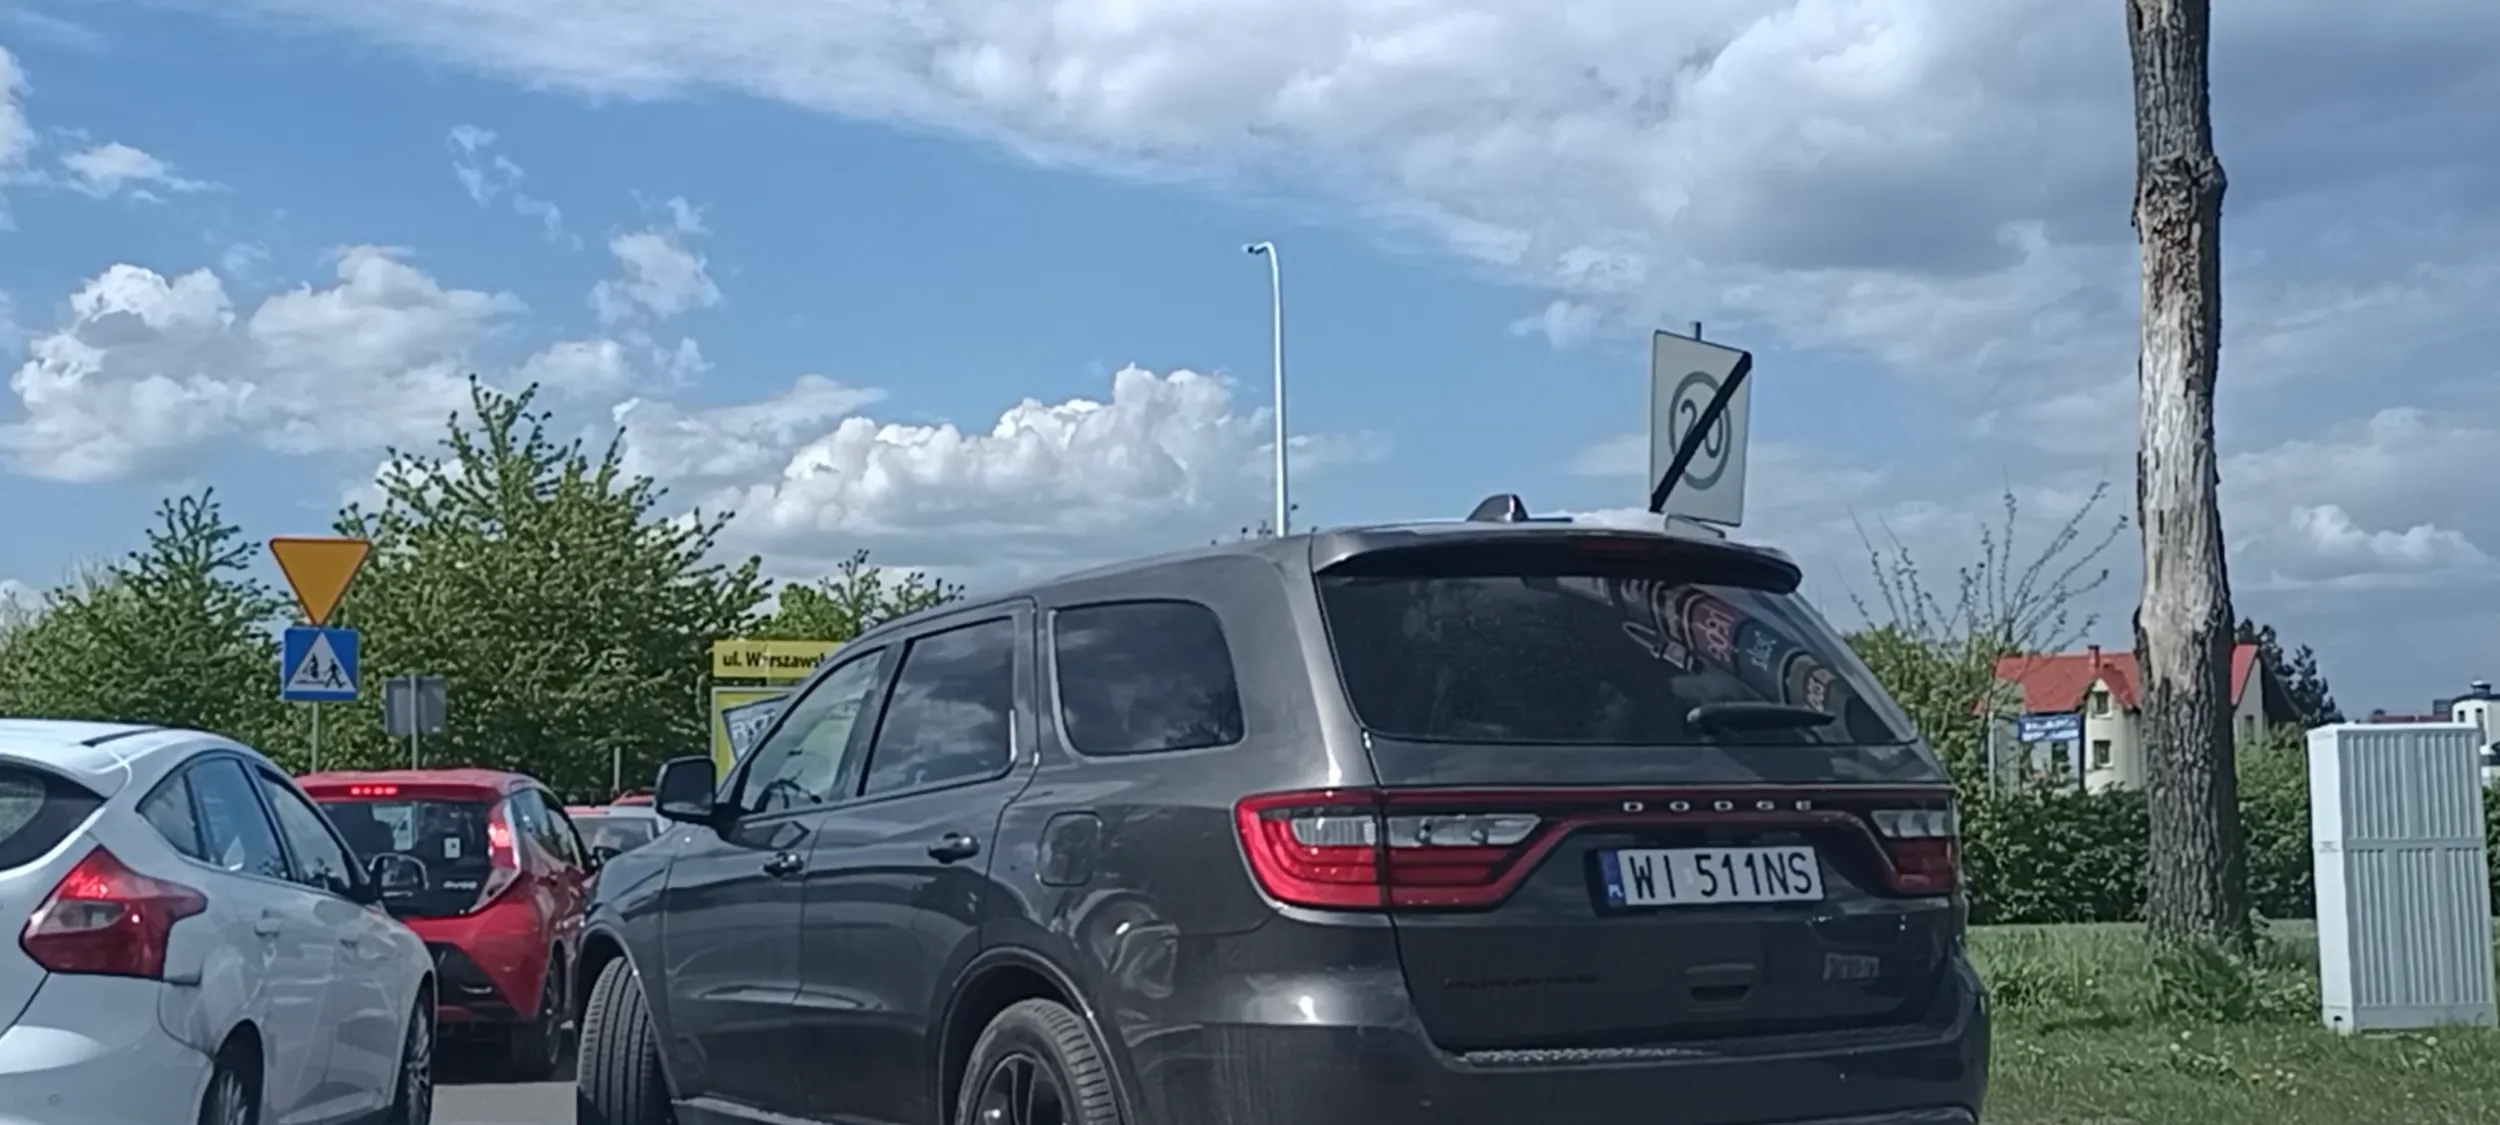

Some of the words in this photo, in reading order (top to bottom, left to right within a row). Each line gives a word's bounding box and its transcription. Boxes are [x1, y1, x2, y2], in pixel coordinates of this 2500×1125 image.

[722, 650, 742, 668] ul.
[1622, 799, 1812, 813] DODGE
[1628, 855, 1677, 899] WI
[1694, 852, 1813, 898] 511NS
